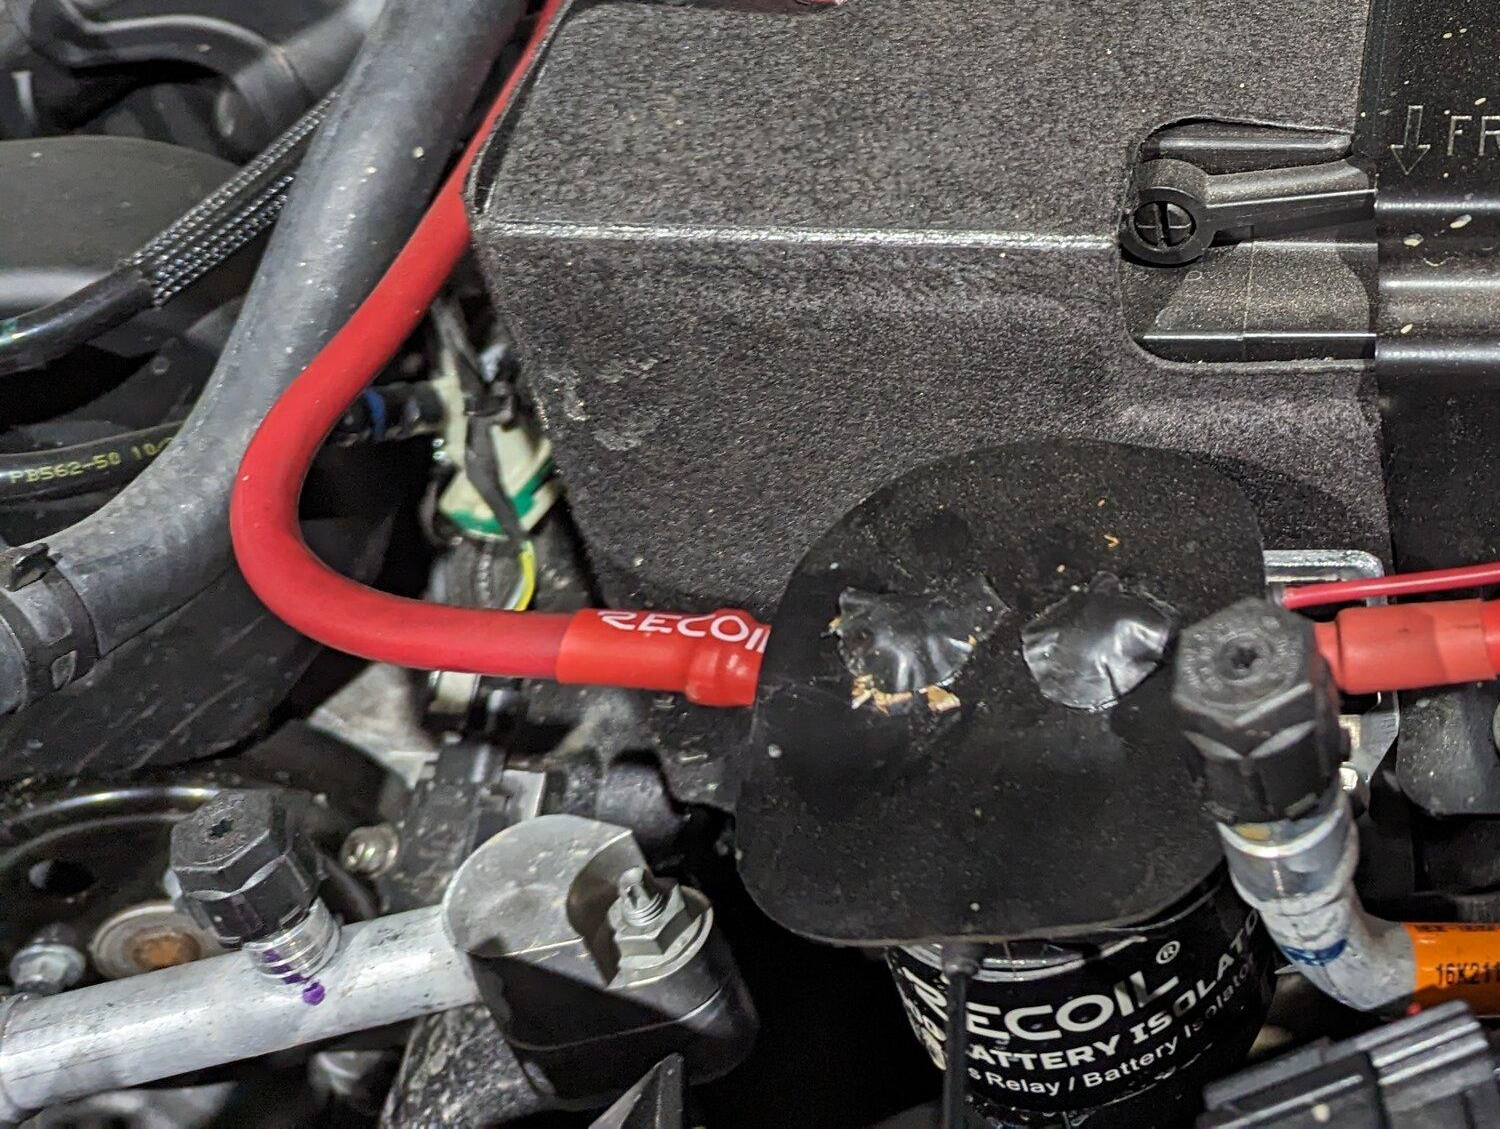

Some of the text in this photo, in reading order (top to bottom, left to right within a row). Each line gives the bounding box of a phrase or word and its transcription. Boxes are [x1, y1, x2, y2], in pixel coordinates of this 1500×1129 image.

[964, 1035, 1122, 1071] ATTERY
[1131, 909, 1260, 1046] ISOLATO
[986, 1070, 1062, 1098] Relay
[1083, 1036, 1178, 1089] Battery
